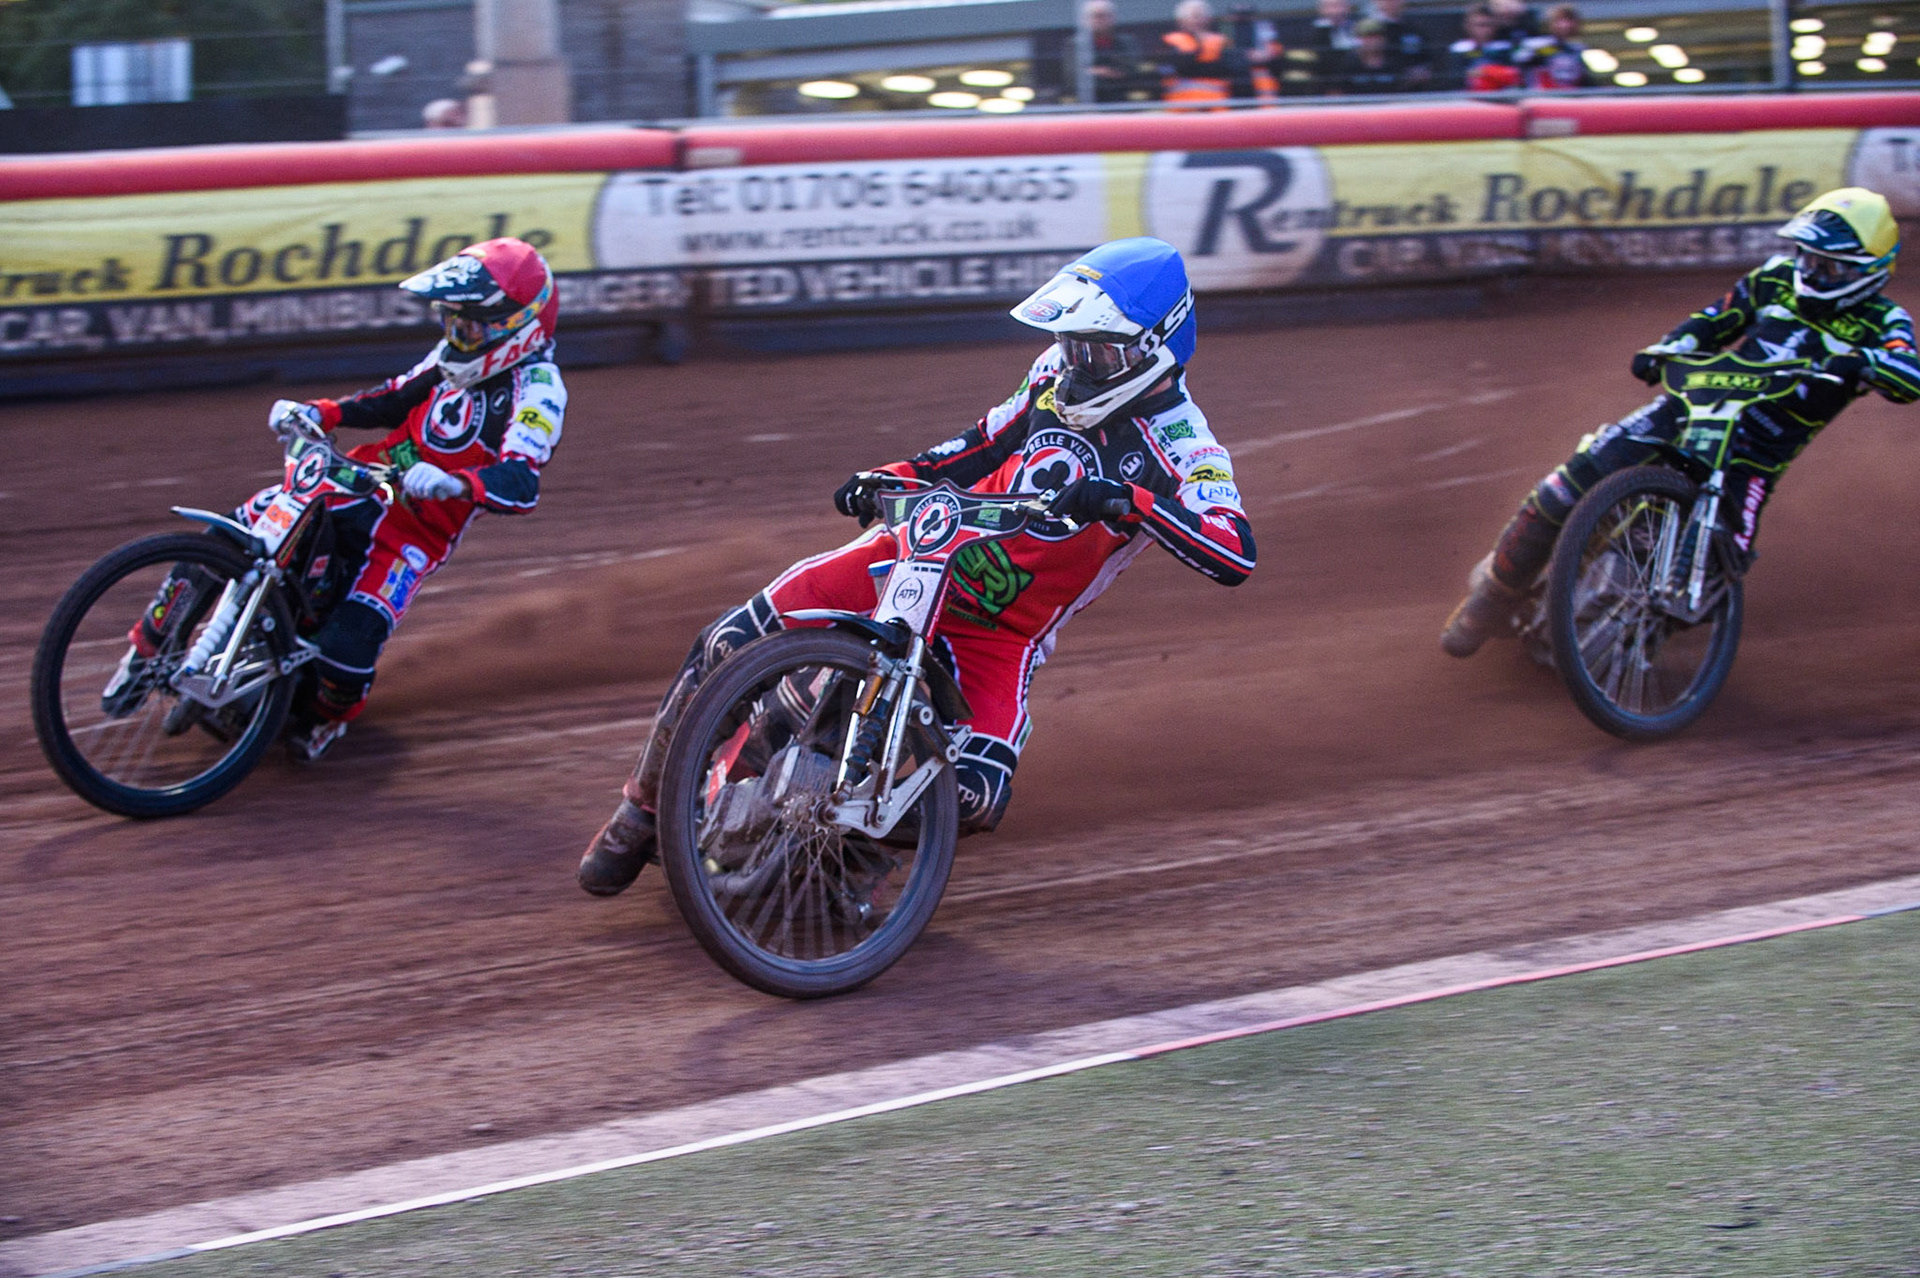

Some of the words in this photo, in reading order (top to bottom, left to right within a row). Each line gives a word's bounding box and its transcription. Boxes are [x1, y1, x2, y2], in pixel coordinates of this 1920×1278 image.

[738, 167, 890, 213] 01706
[1478, 165, 1816, 224] Rochdale
[1028, 434, 1066, 453] BELLE
[1069, 439, 1093, 463] VUE
